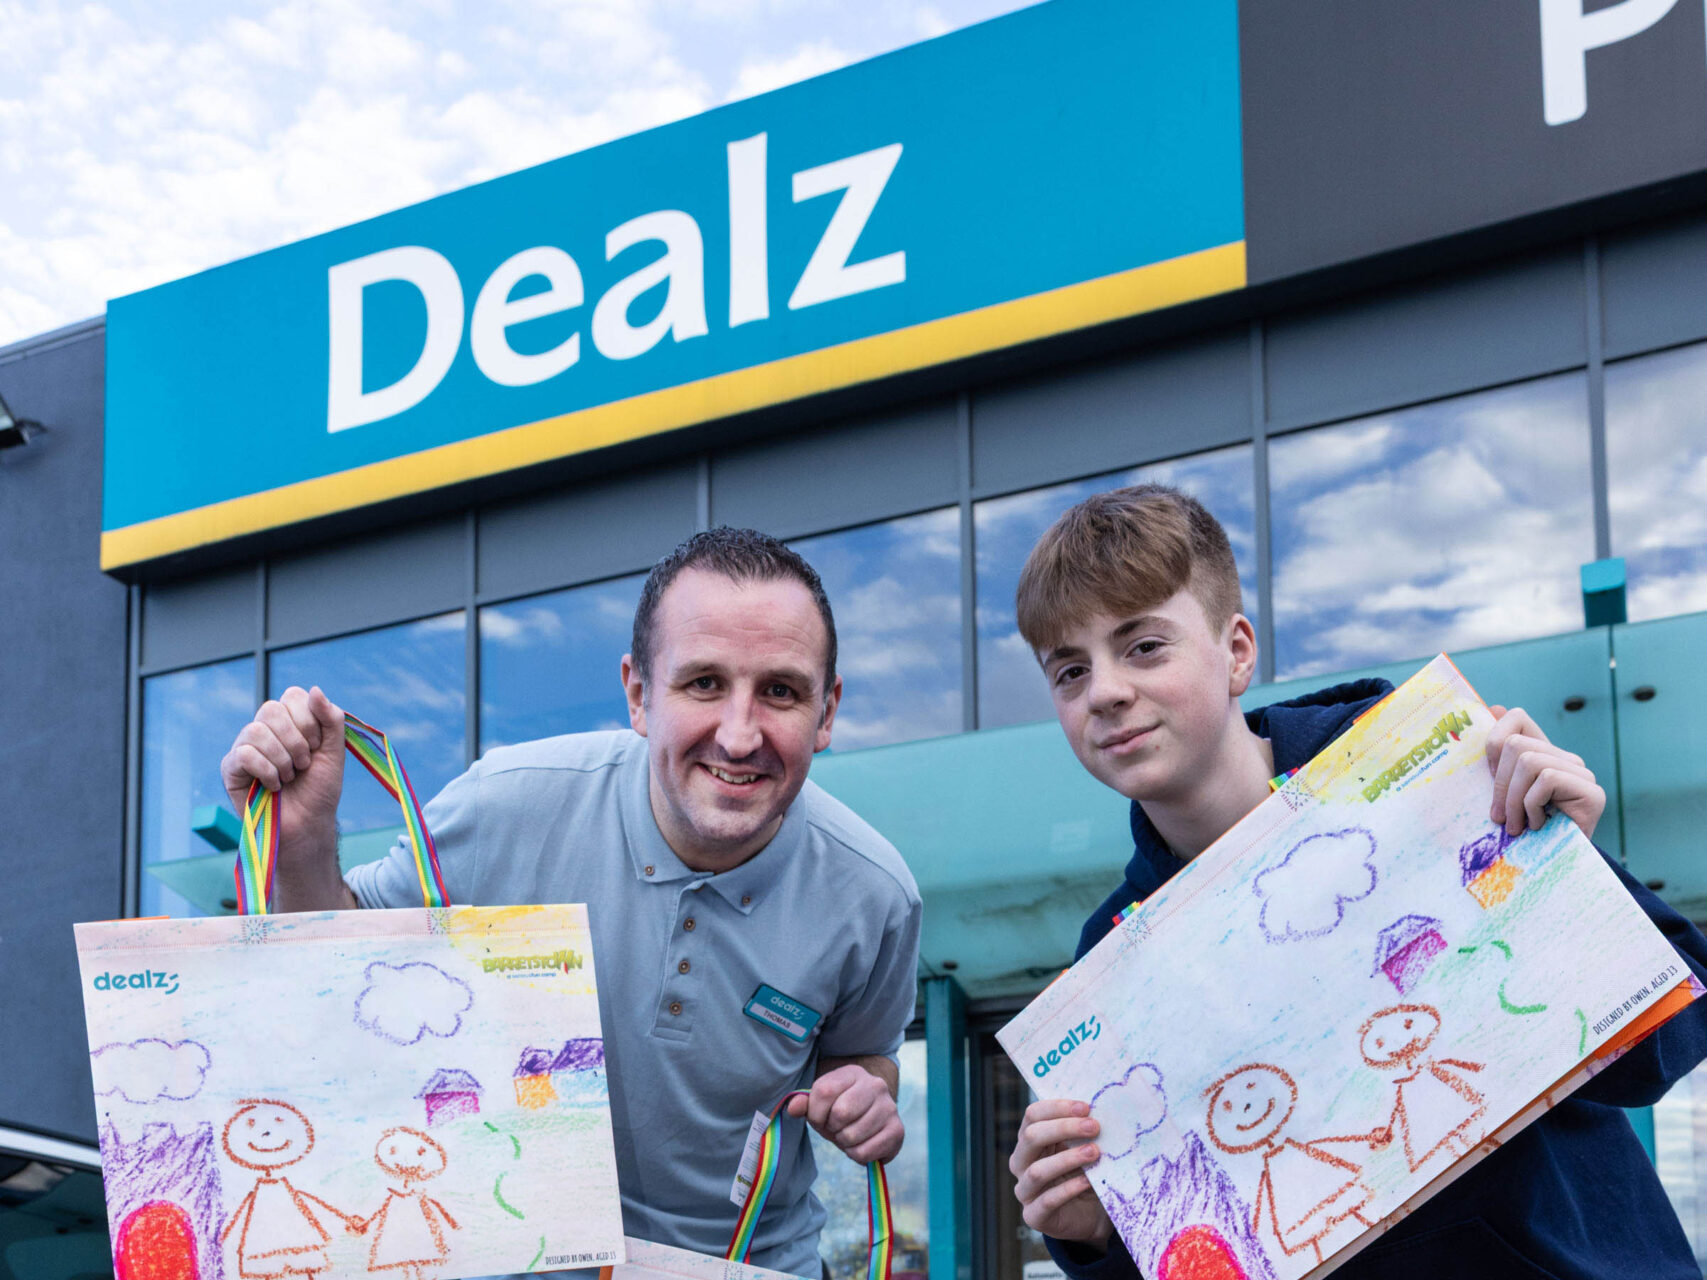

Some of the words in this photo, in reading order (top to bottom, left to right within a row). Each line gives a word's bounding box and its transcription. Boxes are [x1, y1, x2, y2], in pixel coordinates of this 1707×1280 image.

[327, 131, 906, 434] Dealz
[1361, 710, 1473, 803] BARRETSTOWN
[481, 949, 583, 974] BARRETSTOWN
[93, 969, 170, 991] dealz
[770, 996, 802, 1016] dealz
[1592, 1007, 1624, 1035] DESIGNED
[1622, 1000, 1633, 1012] BY
[1650, 972, 1669, 989] AGED
[1666, 965, 1678, 977] 13
[763, 1009, 792, 1029] THOMAS
[1033, 1020, 1094, 1078] dealz
[545, 1254, 571, 1265] DESIGNED
